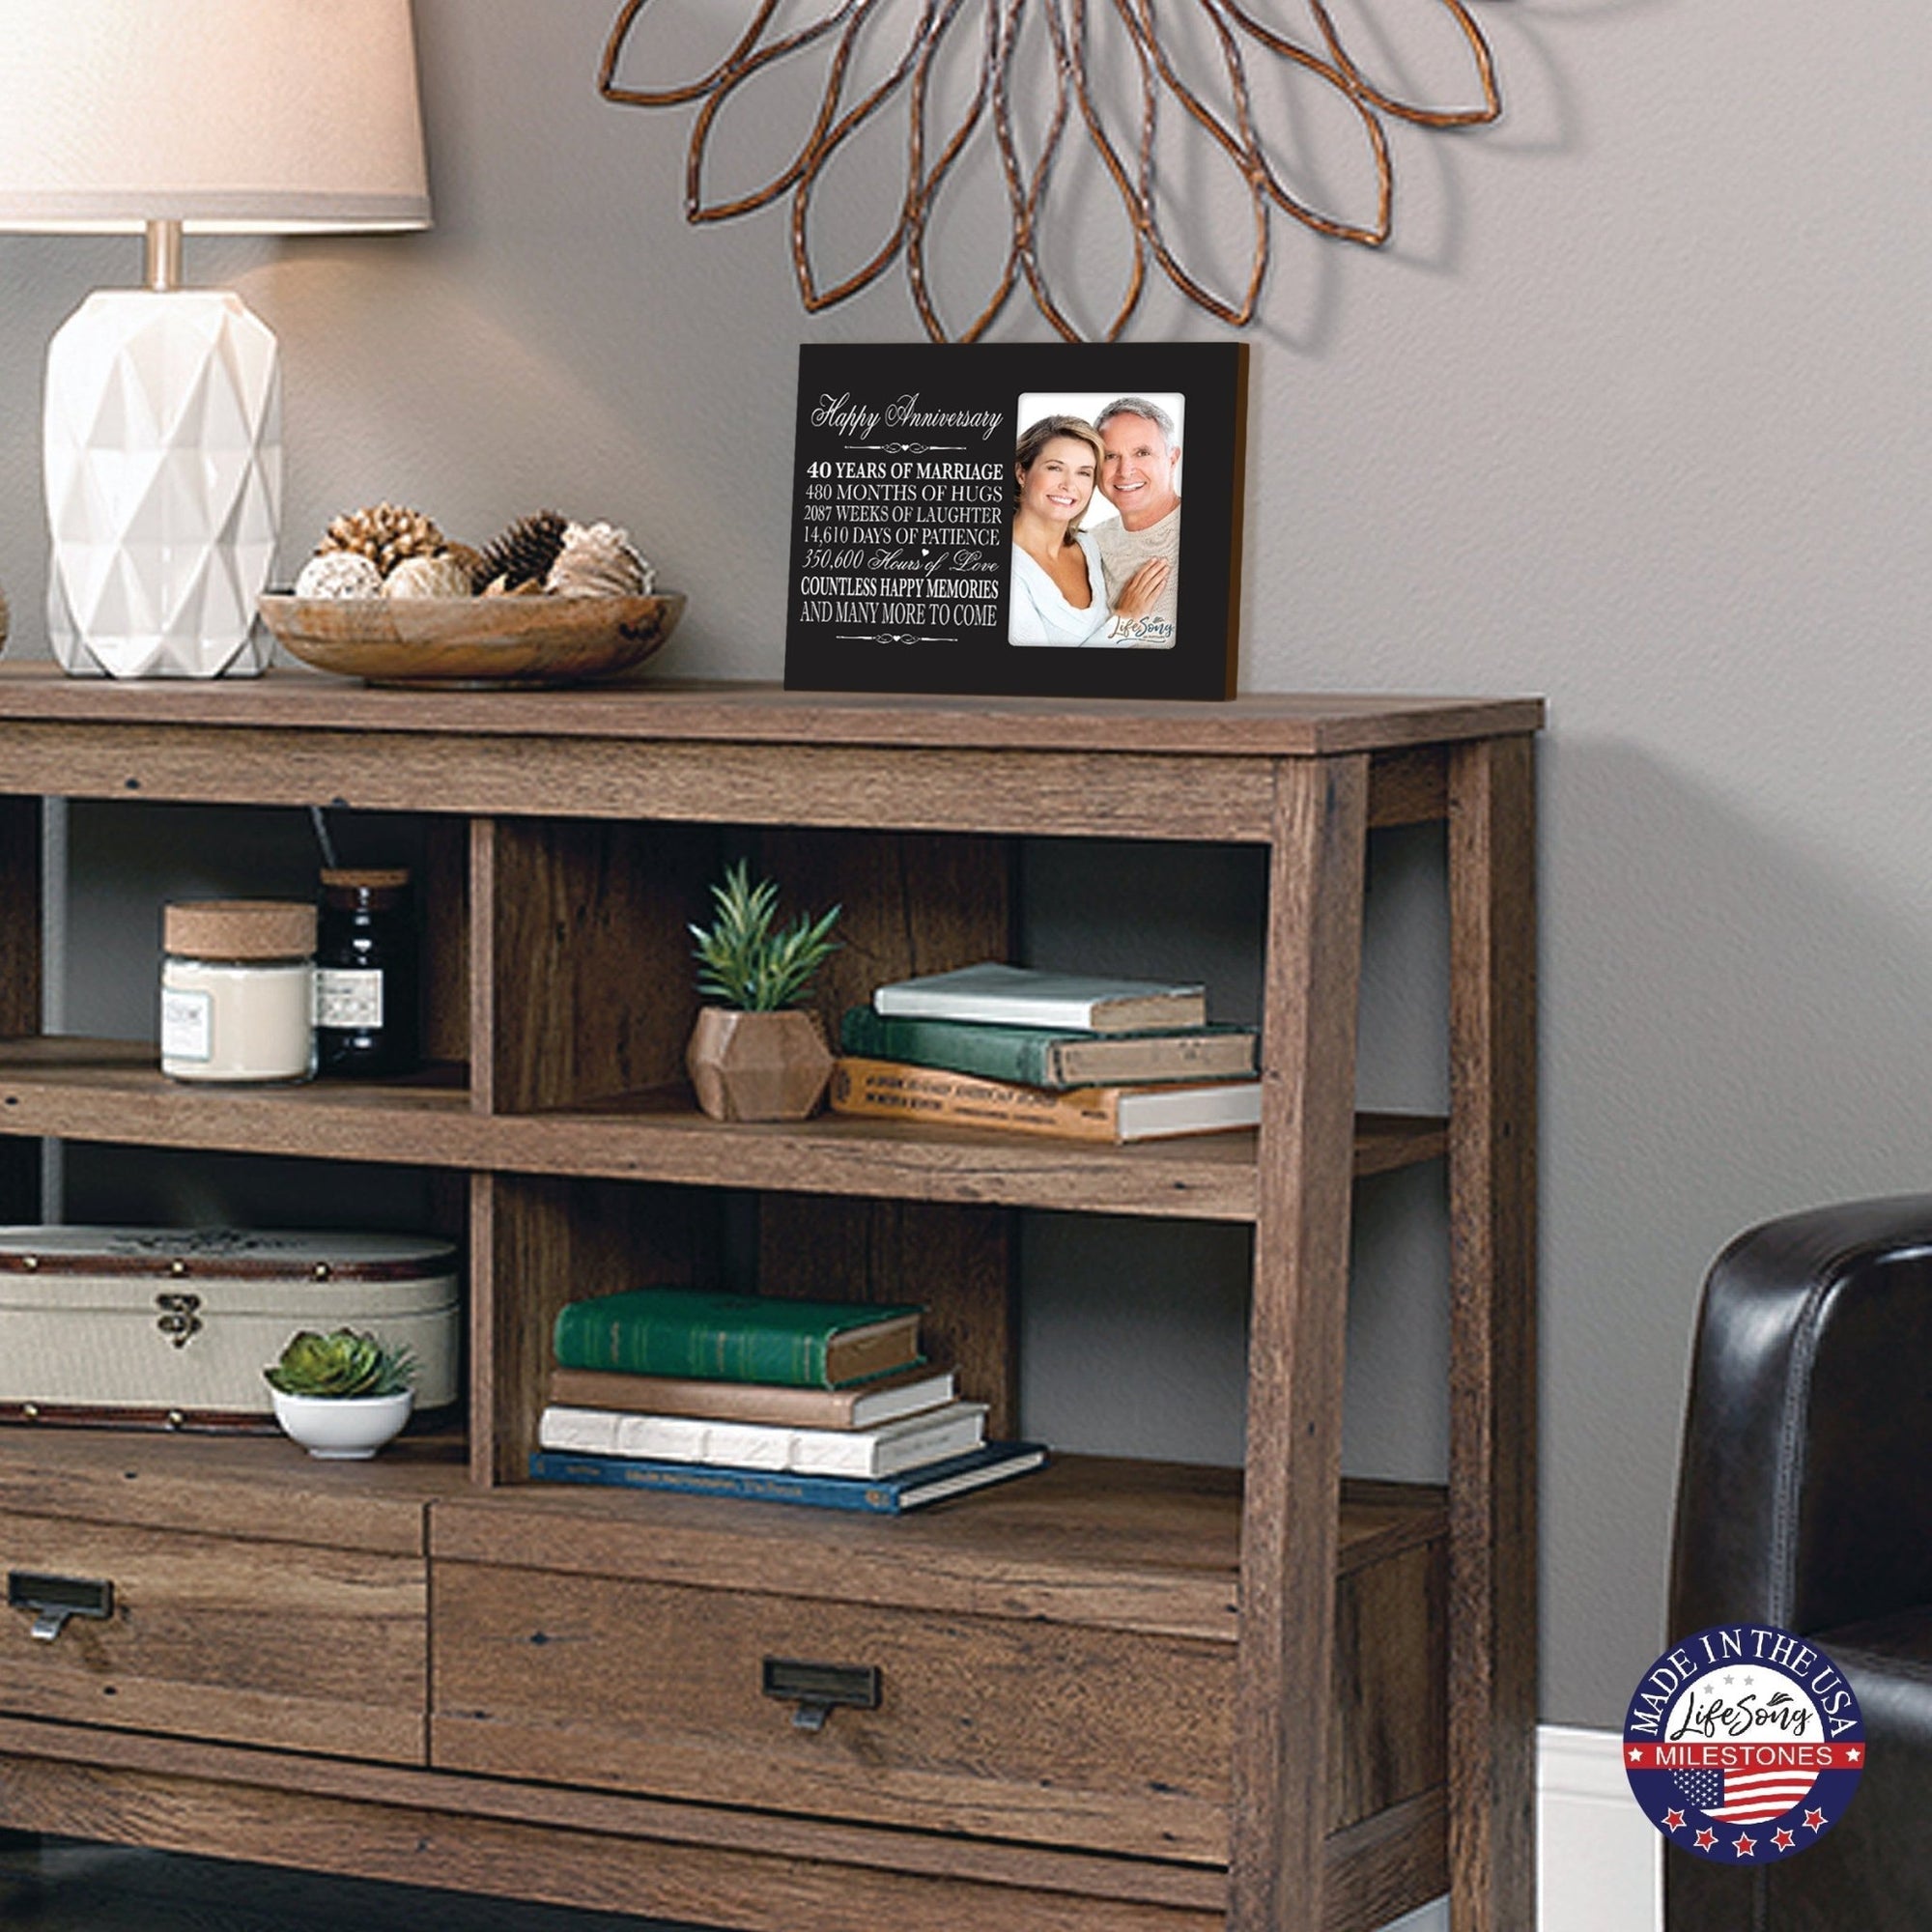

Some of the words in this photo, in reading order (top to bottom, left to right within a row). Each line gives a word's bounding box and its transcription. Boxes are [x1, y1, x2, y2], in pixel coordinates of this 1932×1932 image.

[811, 392, 880, 440] Happy
[885, 392, 1003, 440] Anniversary
[807, 462, 832, 478] 40
[836, 462, 886, 478] YEARS
[891, 463, 913, 478] OF
[917, 464, 1003, 480] MARRIAGE
[806, 484, 833, 500] 480
[837, 485, 917, 501] MONTHS
[922, 486, 947, 501] OF
[952, 486, 1003, 502] HUGS
[804, 505, 833, 521] 2087
[836, 505, 889, 522] WEEKS
[892, 506, 913, 522] OF
[918, 507, 1002, 524] LAUGHTER
[804, 526, 848, 547] 14,610
[853, 527, 892, 544] DAYS
[895, 528, 918, 544] OF
[922, 529, 1000, 546] PATIENCE
[802, 549, 864, 570] 350,600
[867, 549, 921, 570] Hours
[924, 552, 949, 578] of
[949, 550, 999, 572] Love
[801, 577, 877, 596] COUNTLESS
[880, 578, 924, 597] HAPPY
[926, 579, 999, 599] MEMORIES
[800, 602, 833, 622] AND
[835, 602, 879, 623] MANY
[882, 603, 925, 624] MORE
[929, 605, 951, 625] TO
[953, 605, 997, 626] COME
